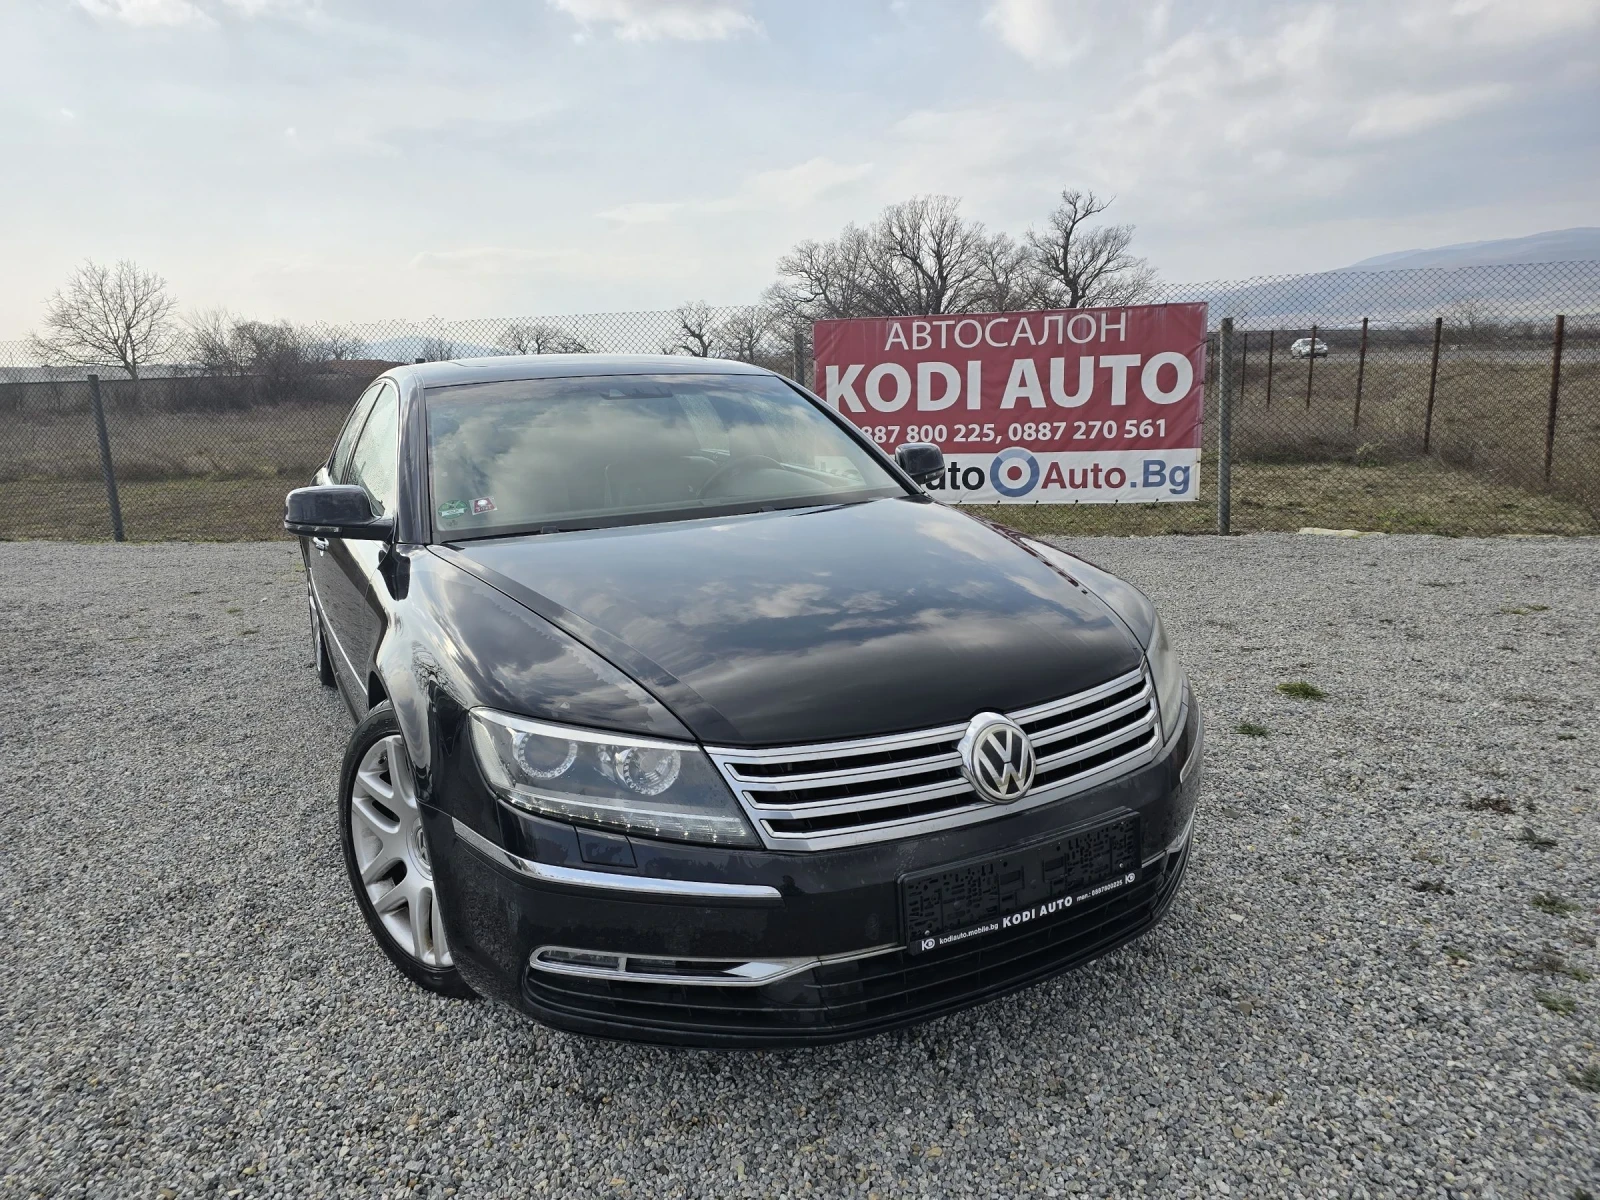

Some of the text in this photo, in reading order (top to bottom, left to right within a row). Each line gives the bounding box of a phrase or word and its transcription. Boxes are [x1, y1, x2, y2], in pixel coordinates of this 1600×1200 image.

[884, 312, 1126, 351] АВТОСАЛОН
[825, 351, 1194, 414] KODI AUTO
[906, 424, 947, 443] 800
[954, 422, 1001, 445] 225,
[1008, 420, 1067, 441] 0887
[1073, 419, 1117, 440] 270
[1124, 418, 1166, 438] 561
[976, 727, 1031, 797] VW
[939, 923, 999, 945] kodiauto.mobile.bg
[1002, 908, 1036, 928] KODI
[1039, 896, 1073, 917] AUTO
